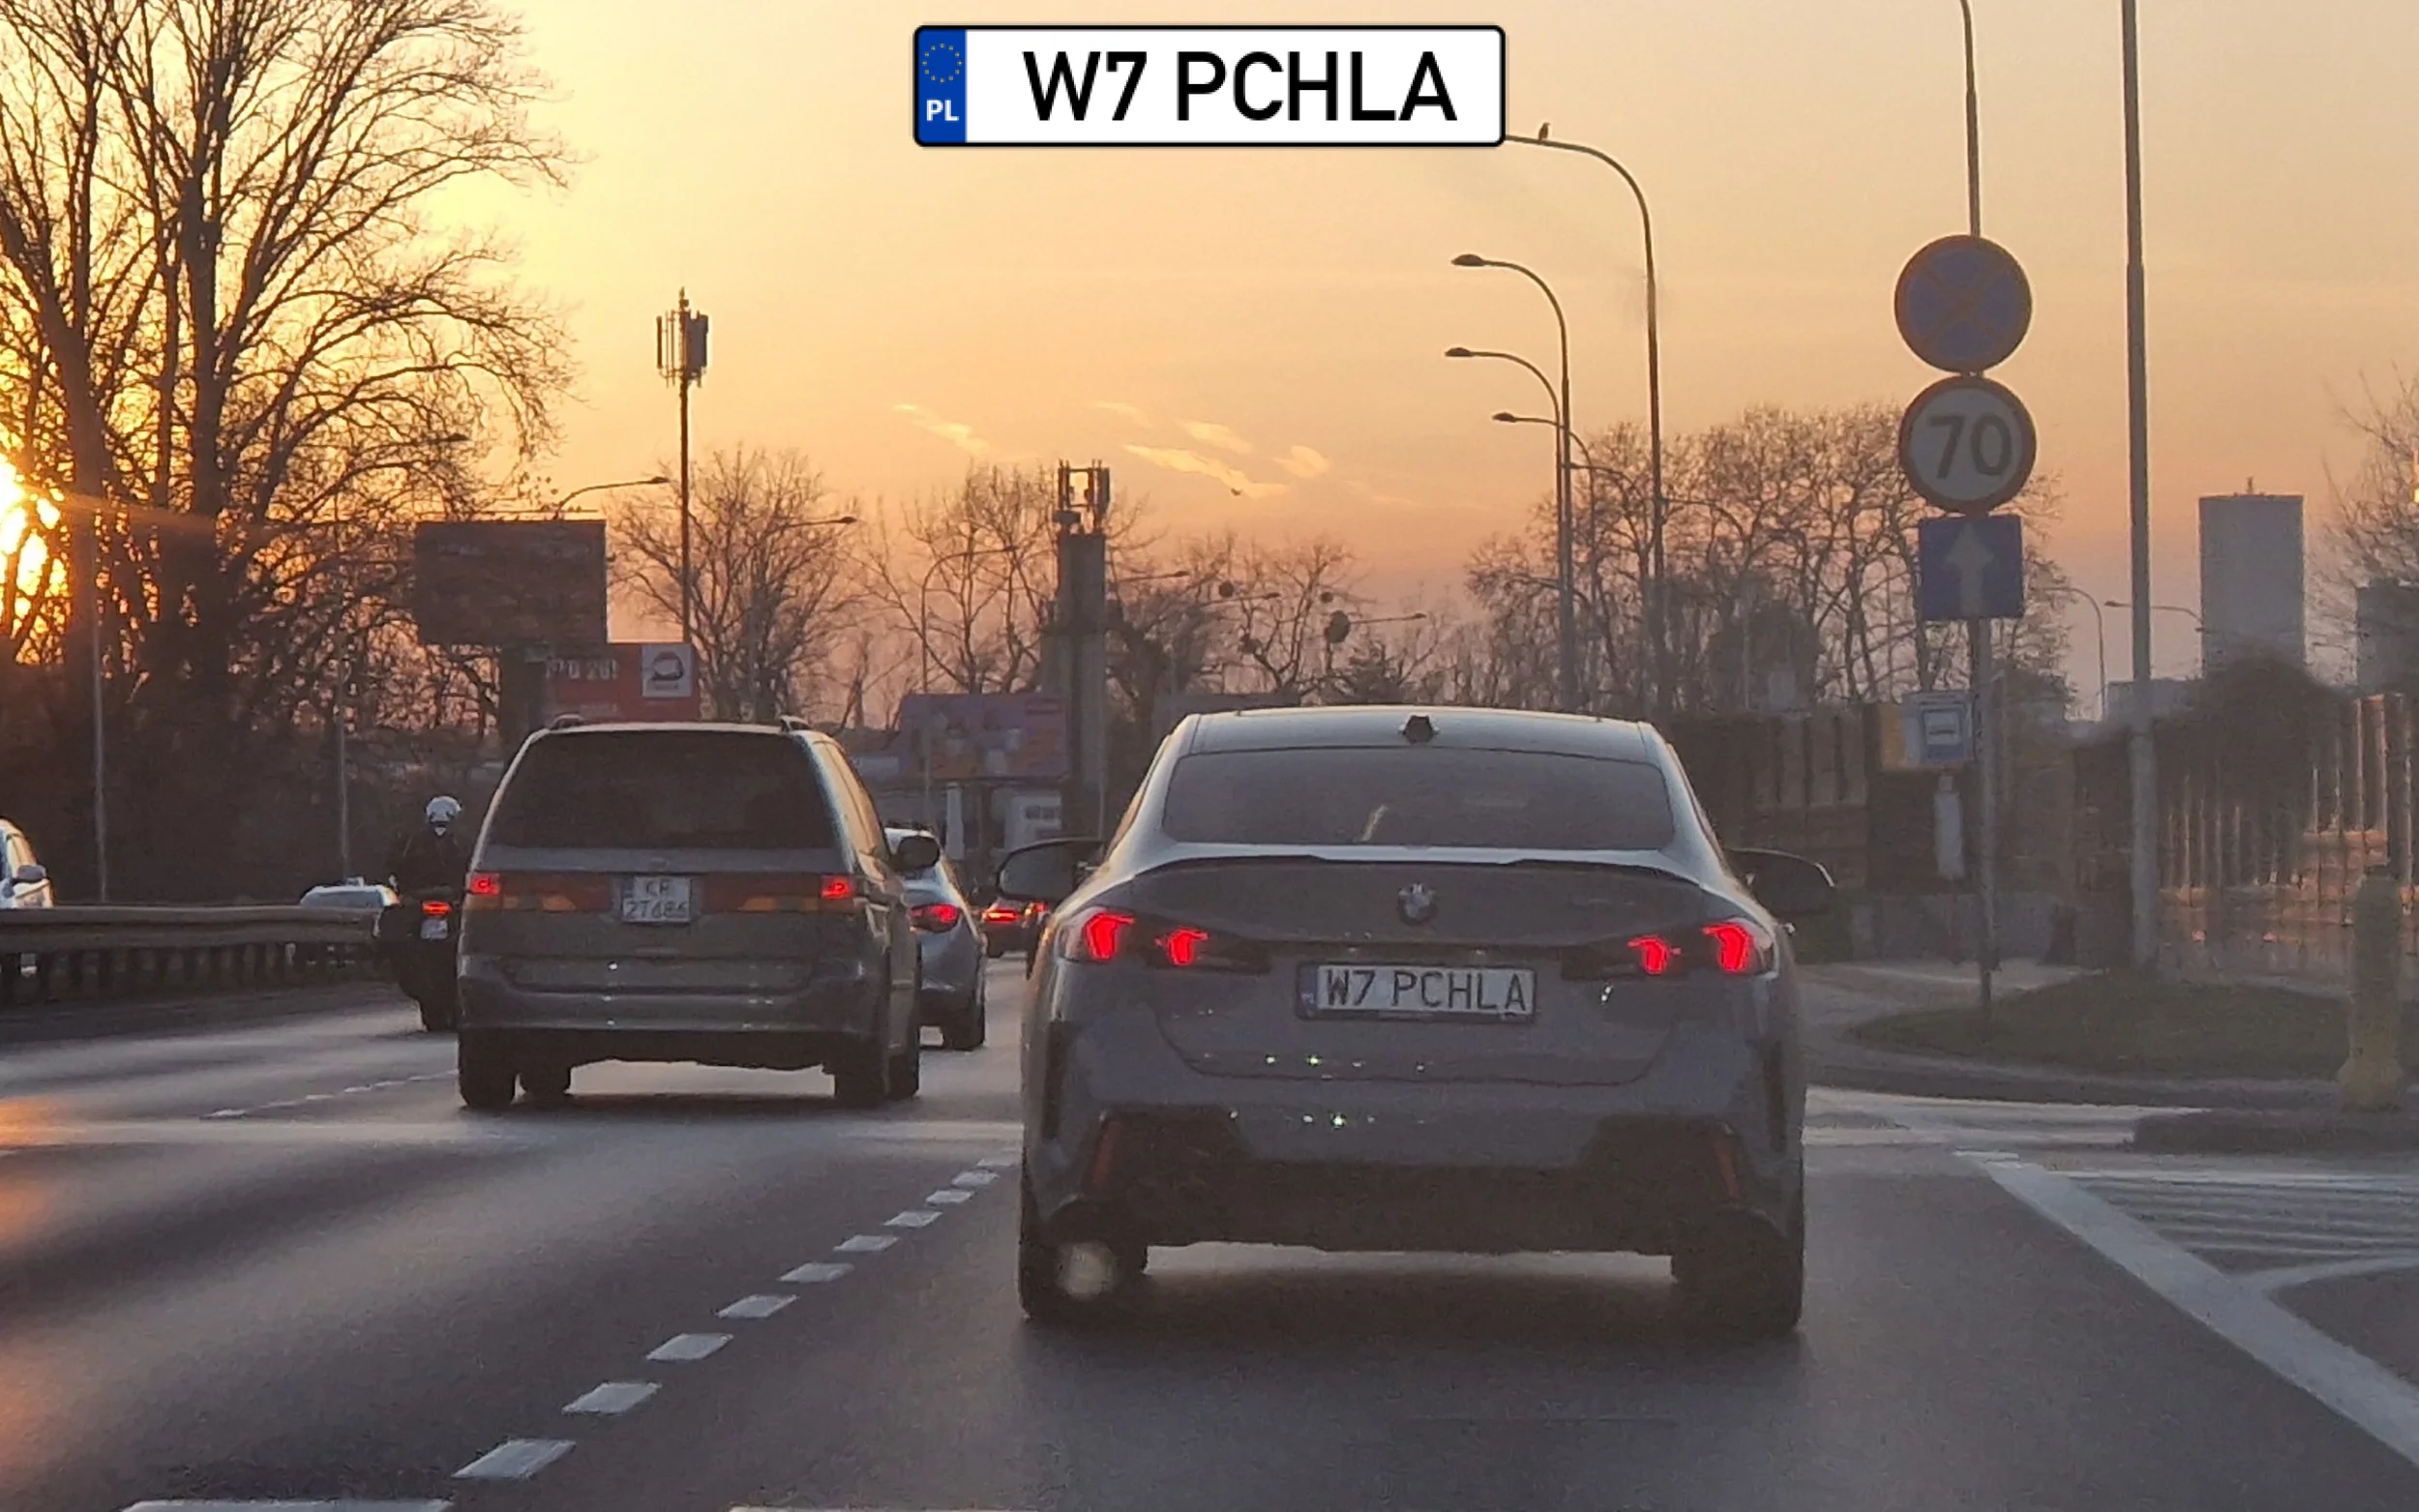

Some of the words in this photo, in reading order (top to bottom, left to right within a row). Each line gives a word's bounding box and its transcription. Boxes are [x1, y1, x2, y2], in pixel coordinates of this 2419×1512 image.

[1927, 413, 2012, 479] 70
[1327, 968, 1376, 1007] W7
[1391, 969, 1527, 1012] PCHLA
